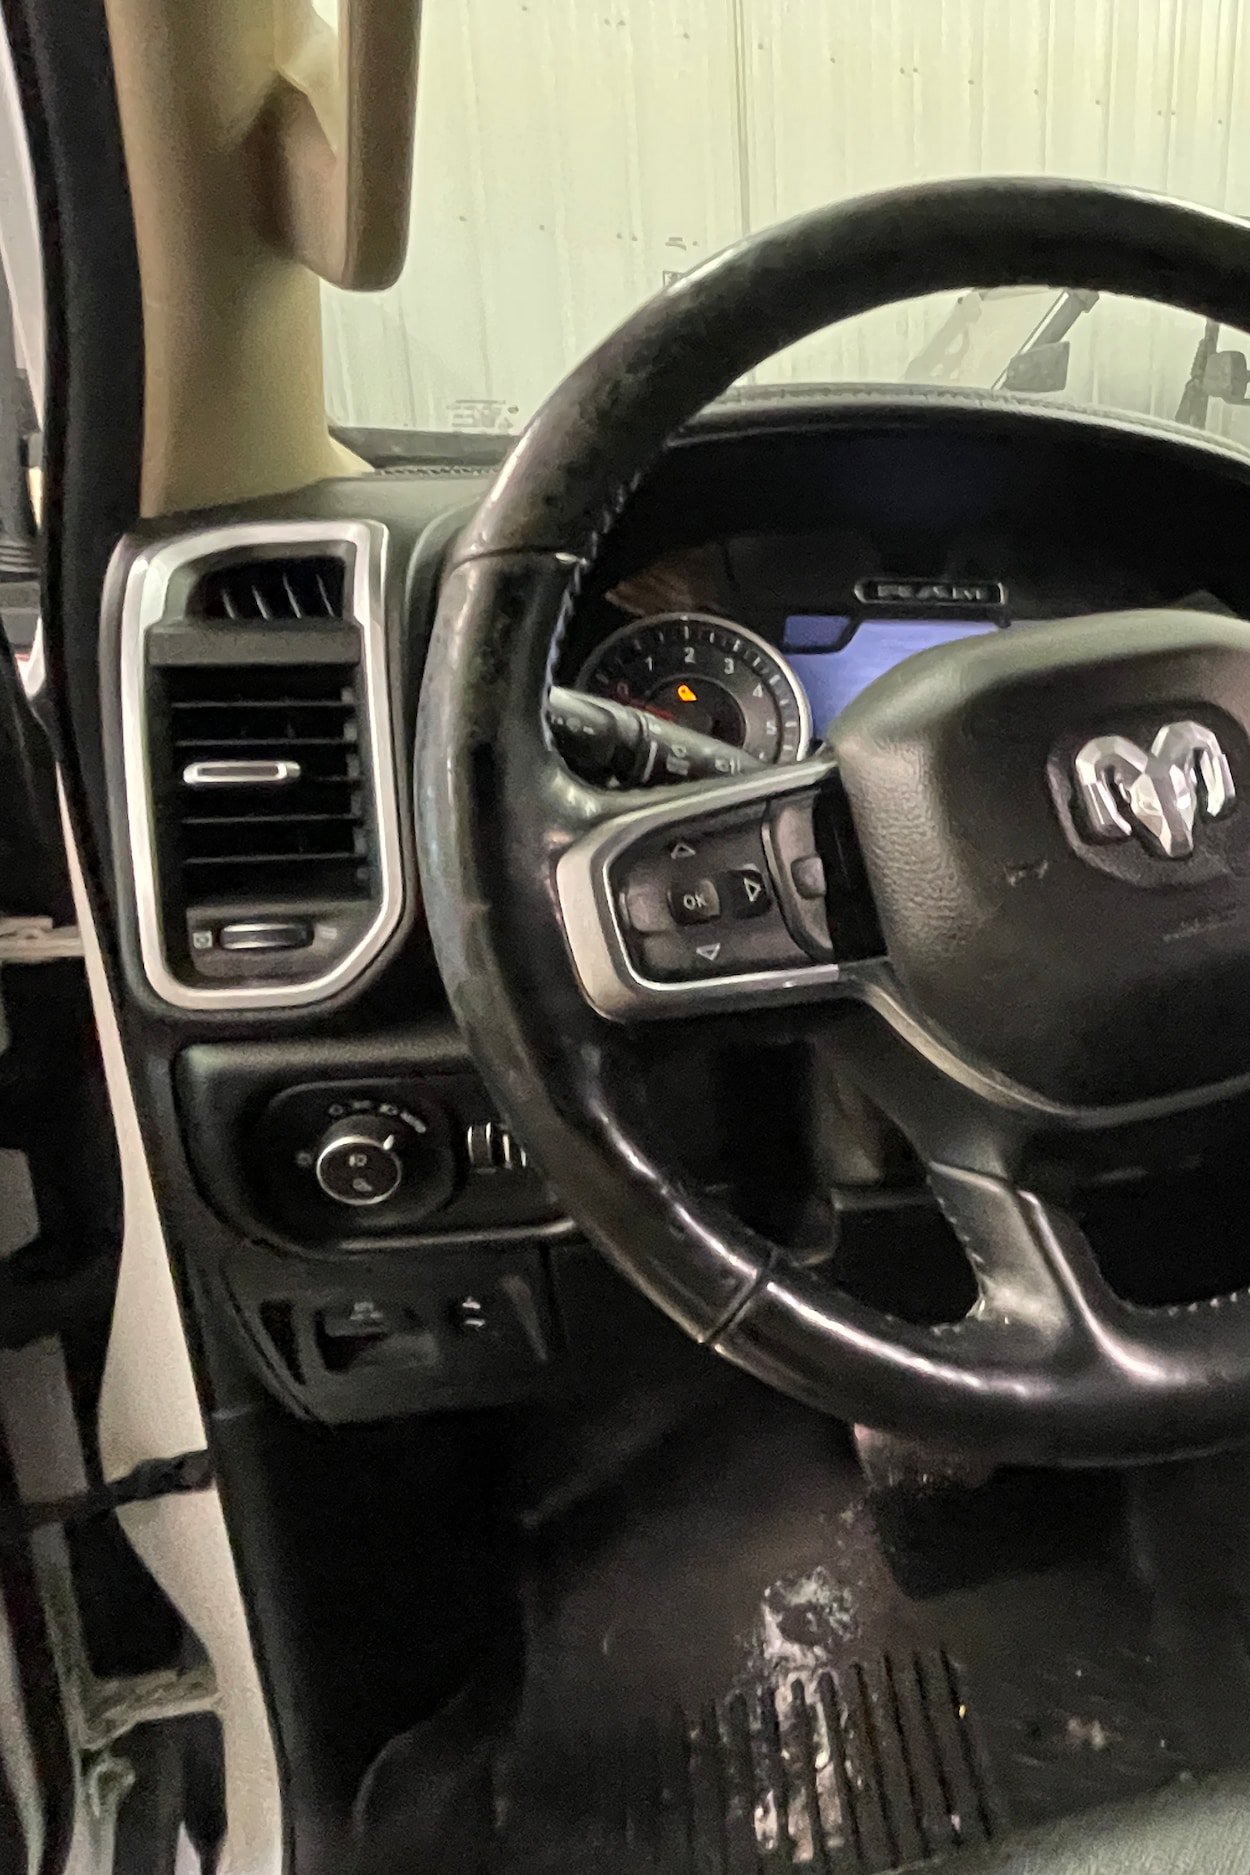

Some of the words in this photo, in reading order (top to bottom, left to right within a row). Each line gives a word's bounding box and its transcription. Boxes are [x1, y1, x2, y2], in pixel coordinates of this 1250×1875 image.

[876, 585, 982, 601] RAM
[684, 646, 697, 664] 2
[724, 656, 736, 675] 3
[752, 682, 764, 699] 4
[766, 720, 777, 736] 5
[682, 891, 709, 911] OK
